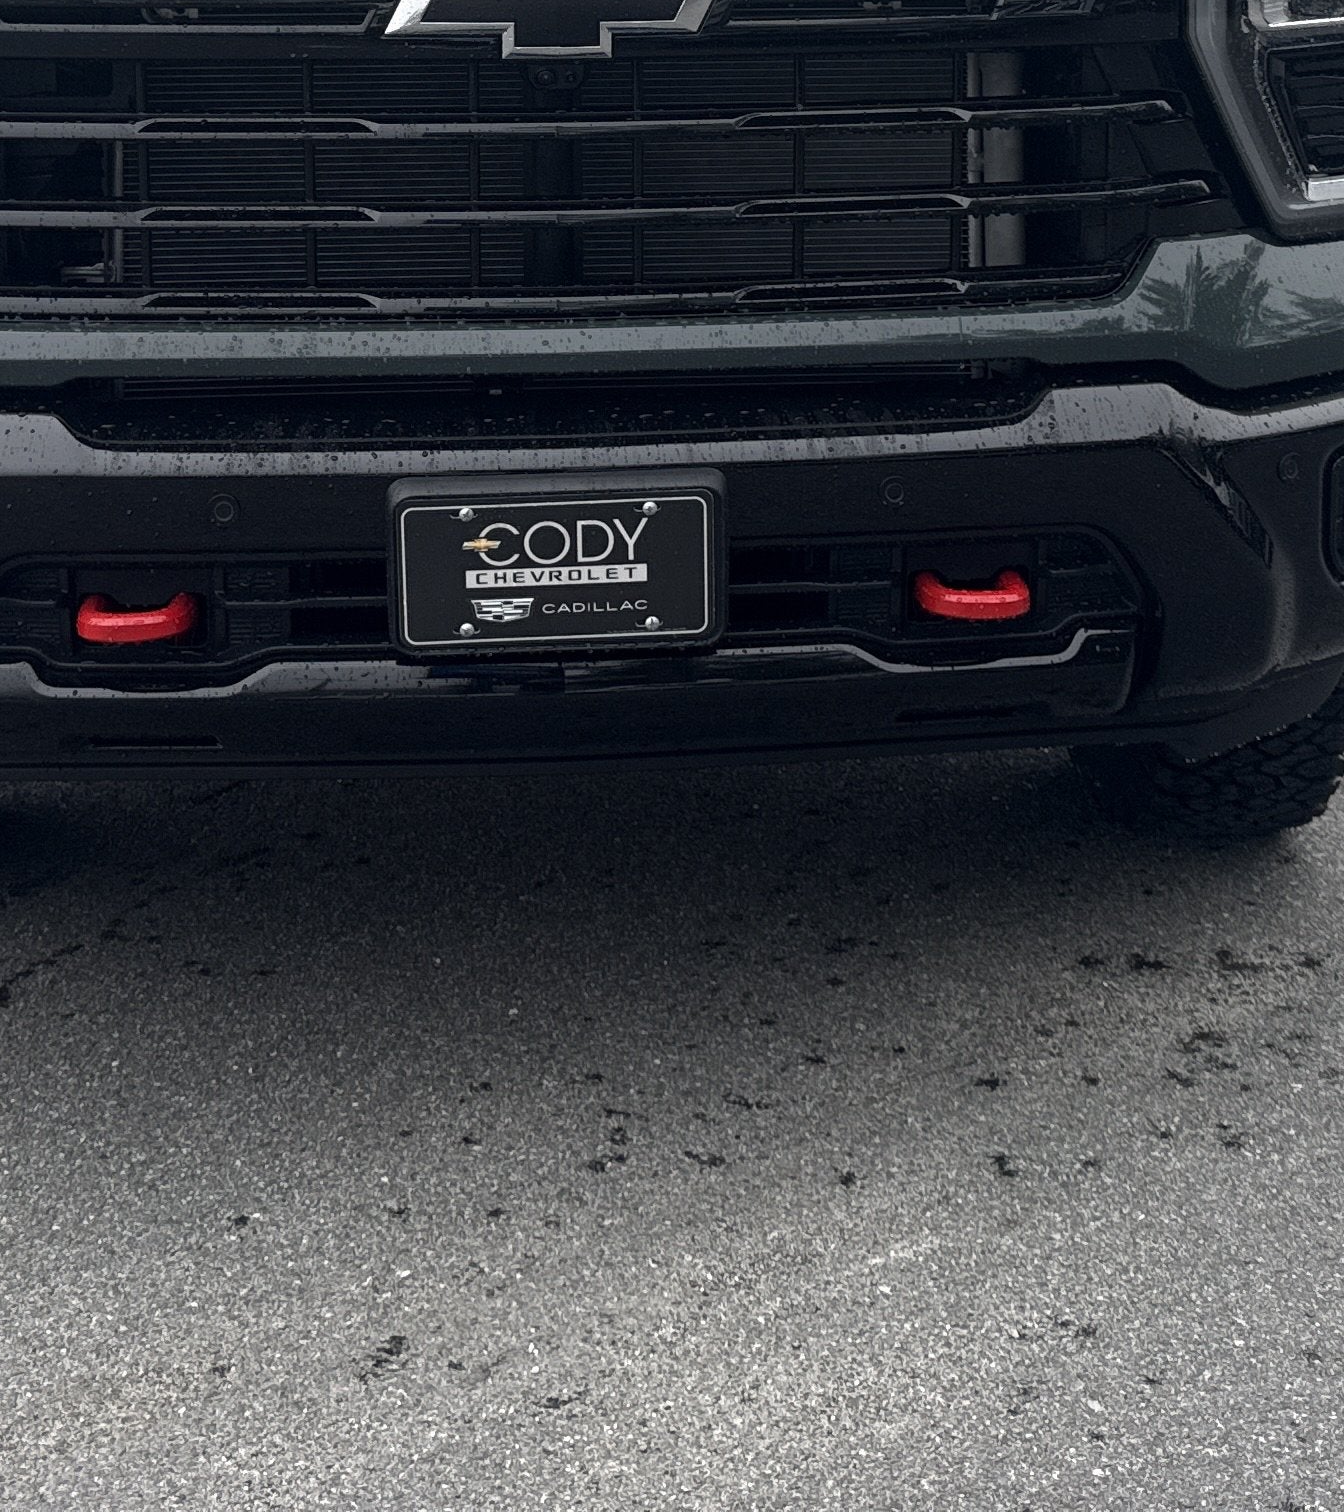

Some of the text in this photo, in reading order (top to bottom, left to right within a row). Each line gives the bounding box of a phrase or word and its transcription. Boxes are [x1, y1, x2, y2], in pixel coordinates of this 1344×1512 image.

[478, 517, 648, 566] CODY
[475, 566, 638, 585] CHEVROLET
[541, 599, 649, 614] CADILLAC
